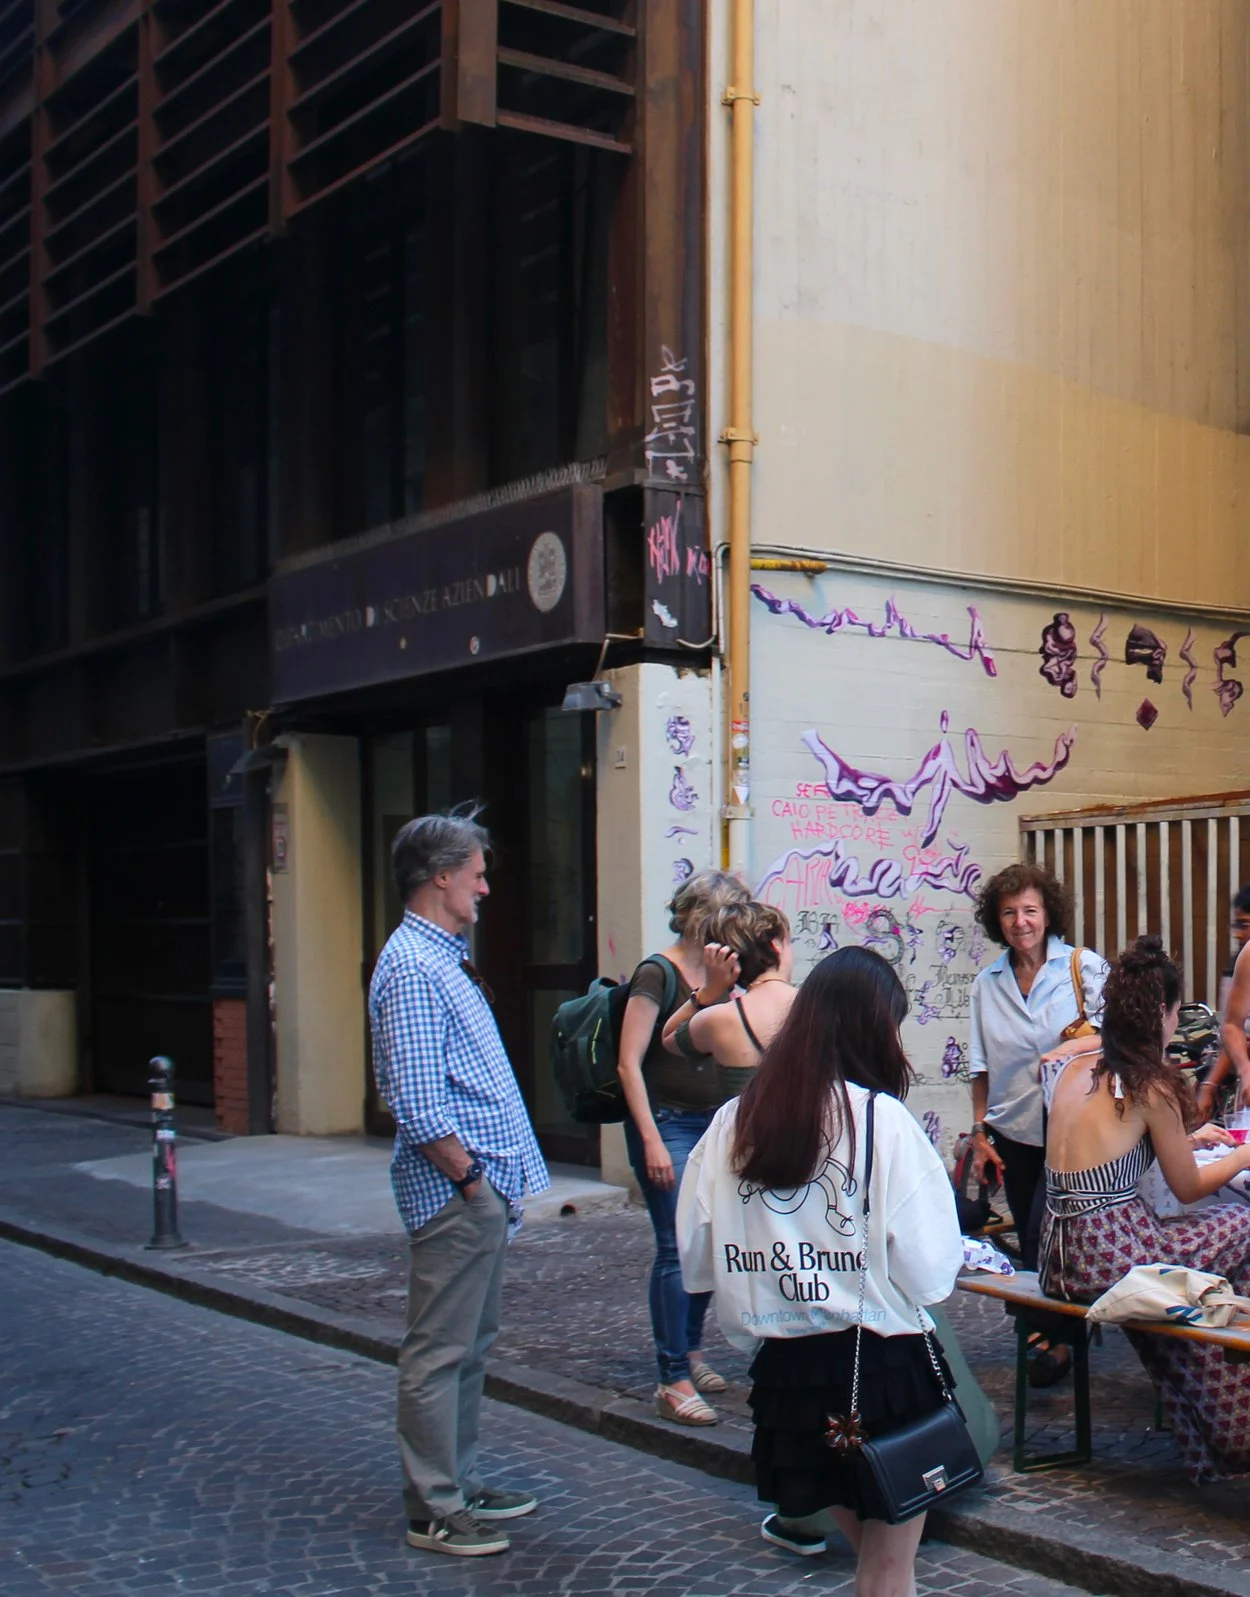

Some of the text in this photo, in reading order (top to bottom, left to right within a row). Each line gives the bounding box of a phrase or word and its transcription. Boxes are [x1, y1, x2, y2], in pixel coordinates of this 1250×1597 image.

[383, 588, 437, 623] SCIENZE
[441, 566, 520, 609] AZIENDALI
[724, 1243, 766, 1273] Run
[770, 1241, 794, 1272] &
[778, 1273, 830, 1302] Club
[810, 1307, 887, 1323] Mnhatan
